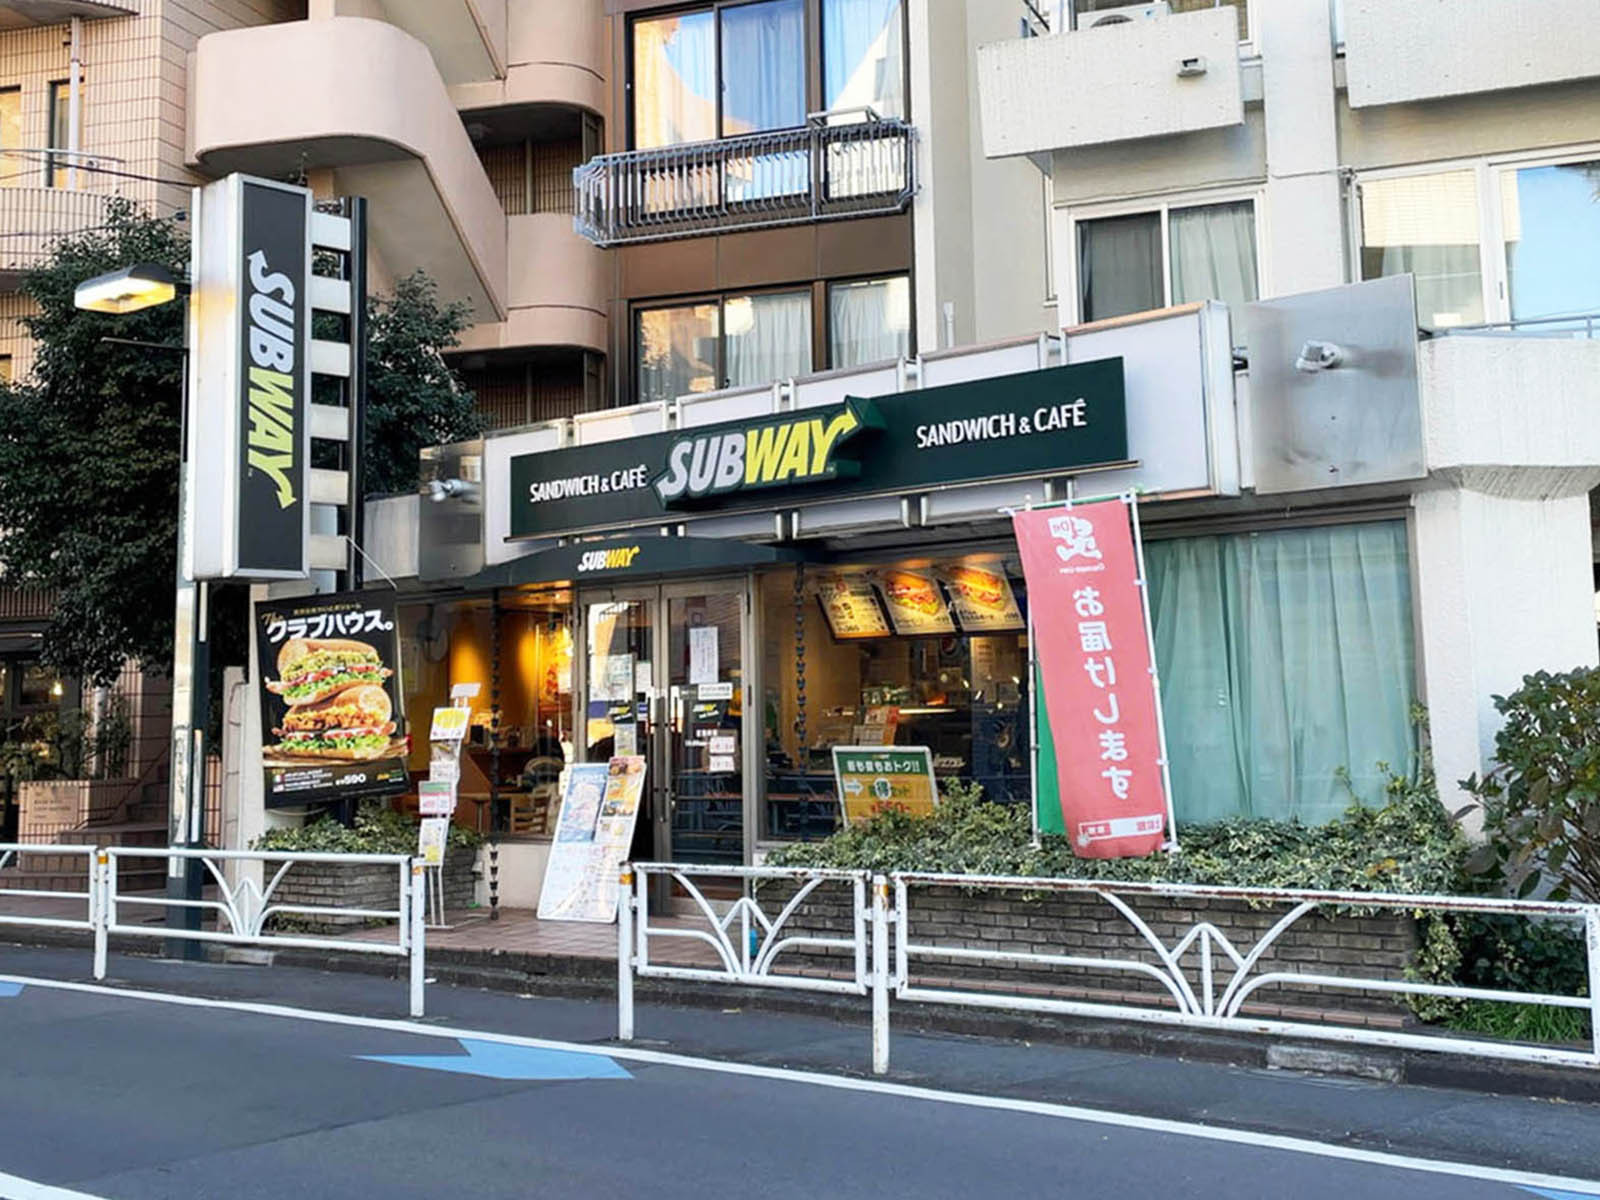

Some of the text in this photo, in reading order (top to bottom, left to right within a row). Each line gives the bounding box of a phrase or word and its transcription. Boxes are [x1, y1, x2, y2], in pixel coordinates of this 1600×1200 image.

[247, 250, 297, 509] SUBWAY
[916, 398, 1087, 448] SANDWICH & CAFÉ
[656, 407, 858, 498] SUBWAY
[529, 464, 648, 503] SANDWICH & CAFÉ
[577, 545, 641, 572] SUBWAY
